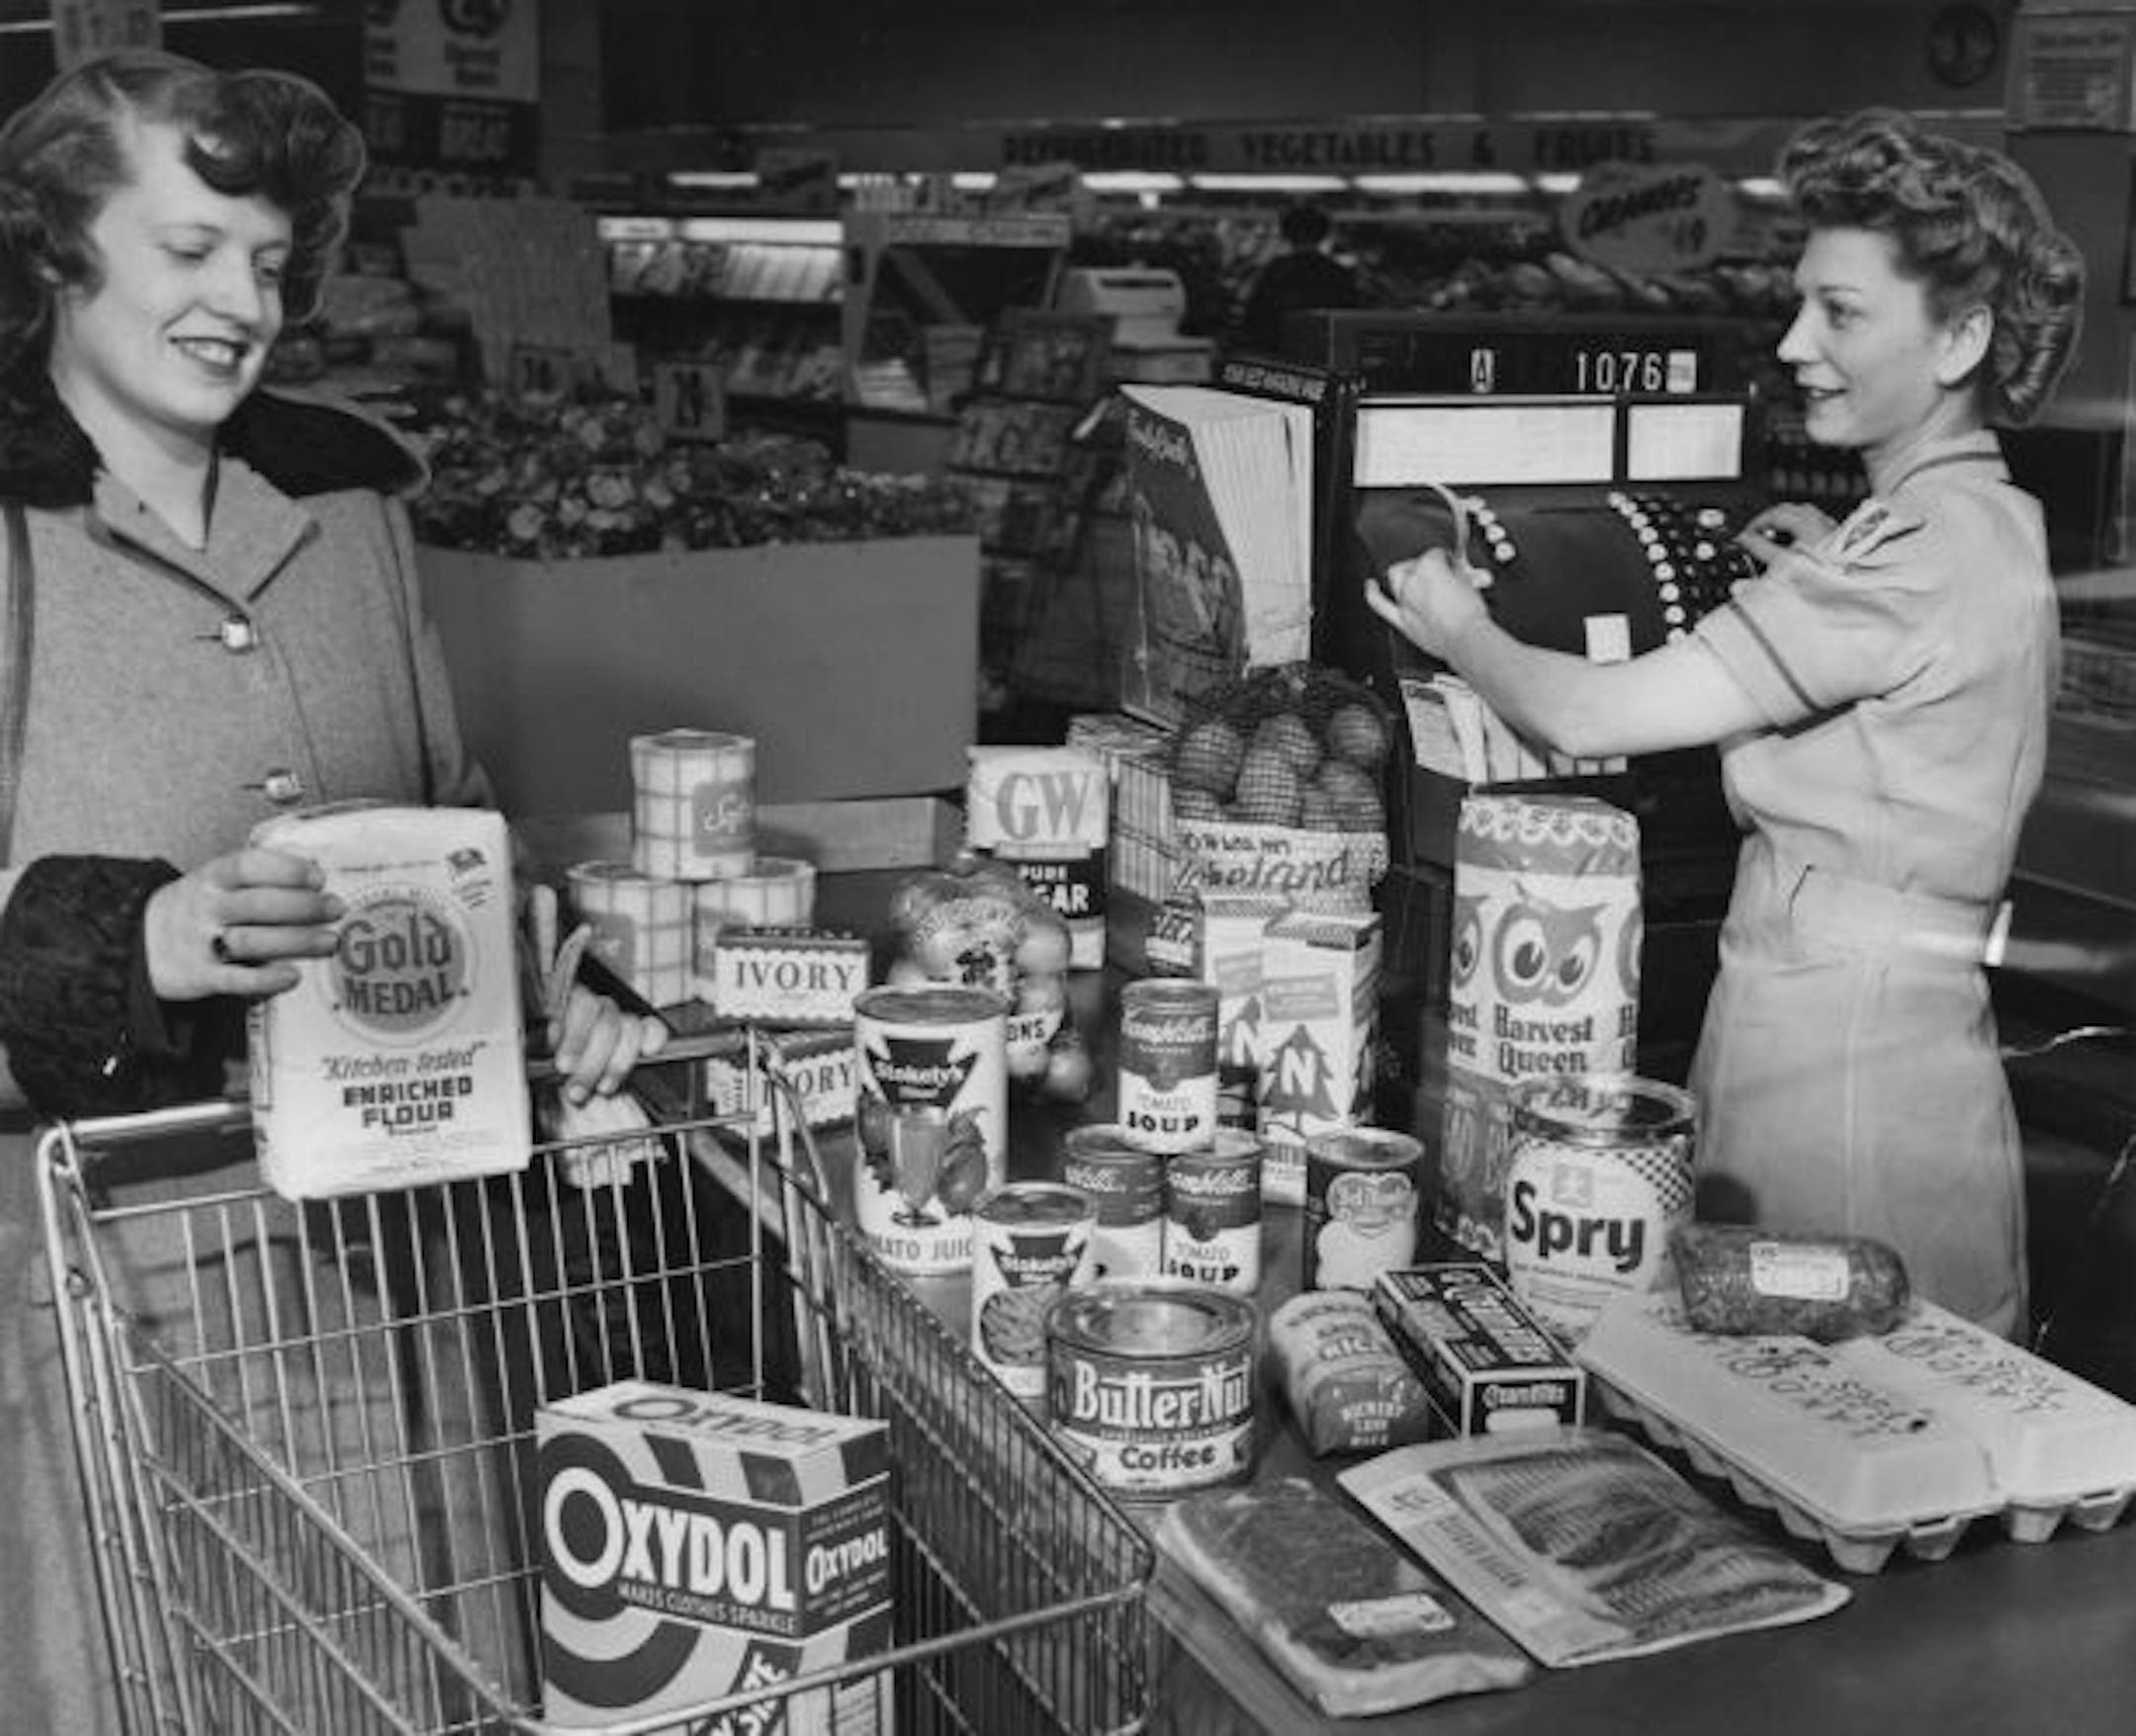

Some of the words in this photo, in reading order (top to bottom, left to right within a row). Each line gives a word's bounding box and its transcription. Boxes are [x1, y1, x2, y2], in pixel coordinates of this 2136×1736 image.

[1241, 131, 1434, 166] VEGETABLES
[996, 772, 1094, 839] GW
[341, 911, 451, 976] Gold
[344, 973, 457, 1014] MEDAL
[737, 960, 857, 990] IVORY
[1494, 1002, 1593, 1041] Harvest
[1280, 1046, 1316, 1095] N
[1499, 1041, 1588, 1078] Queen
[342, 1075, 474, 1107] ENRICHED
[763, 1062, 852, 1106] IORY
[361, 1101, 454, 1128] FLOUR
[1127, 1111, 1200, 1132] SOUP
[1511, 1179, 1646, 1273] Spry
[612, 1397, 838, 1444] OXYDOL
[1118, 1444, 1216, 1470] Coffee
[545, 1467, 797, 1611] OXYDOL
[805, 1526, 889, 1596] OXYDOL
[730, 1604, 796, 1634] SPARKLE
